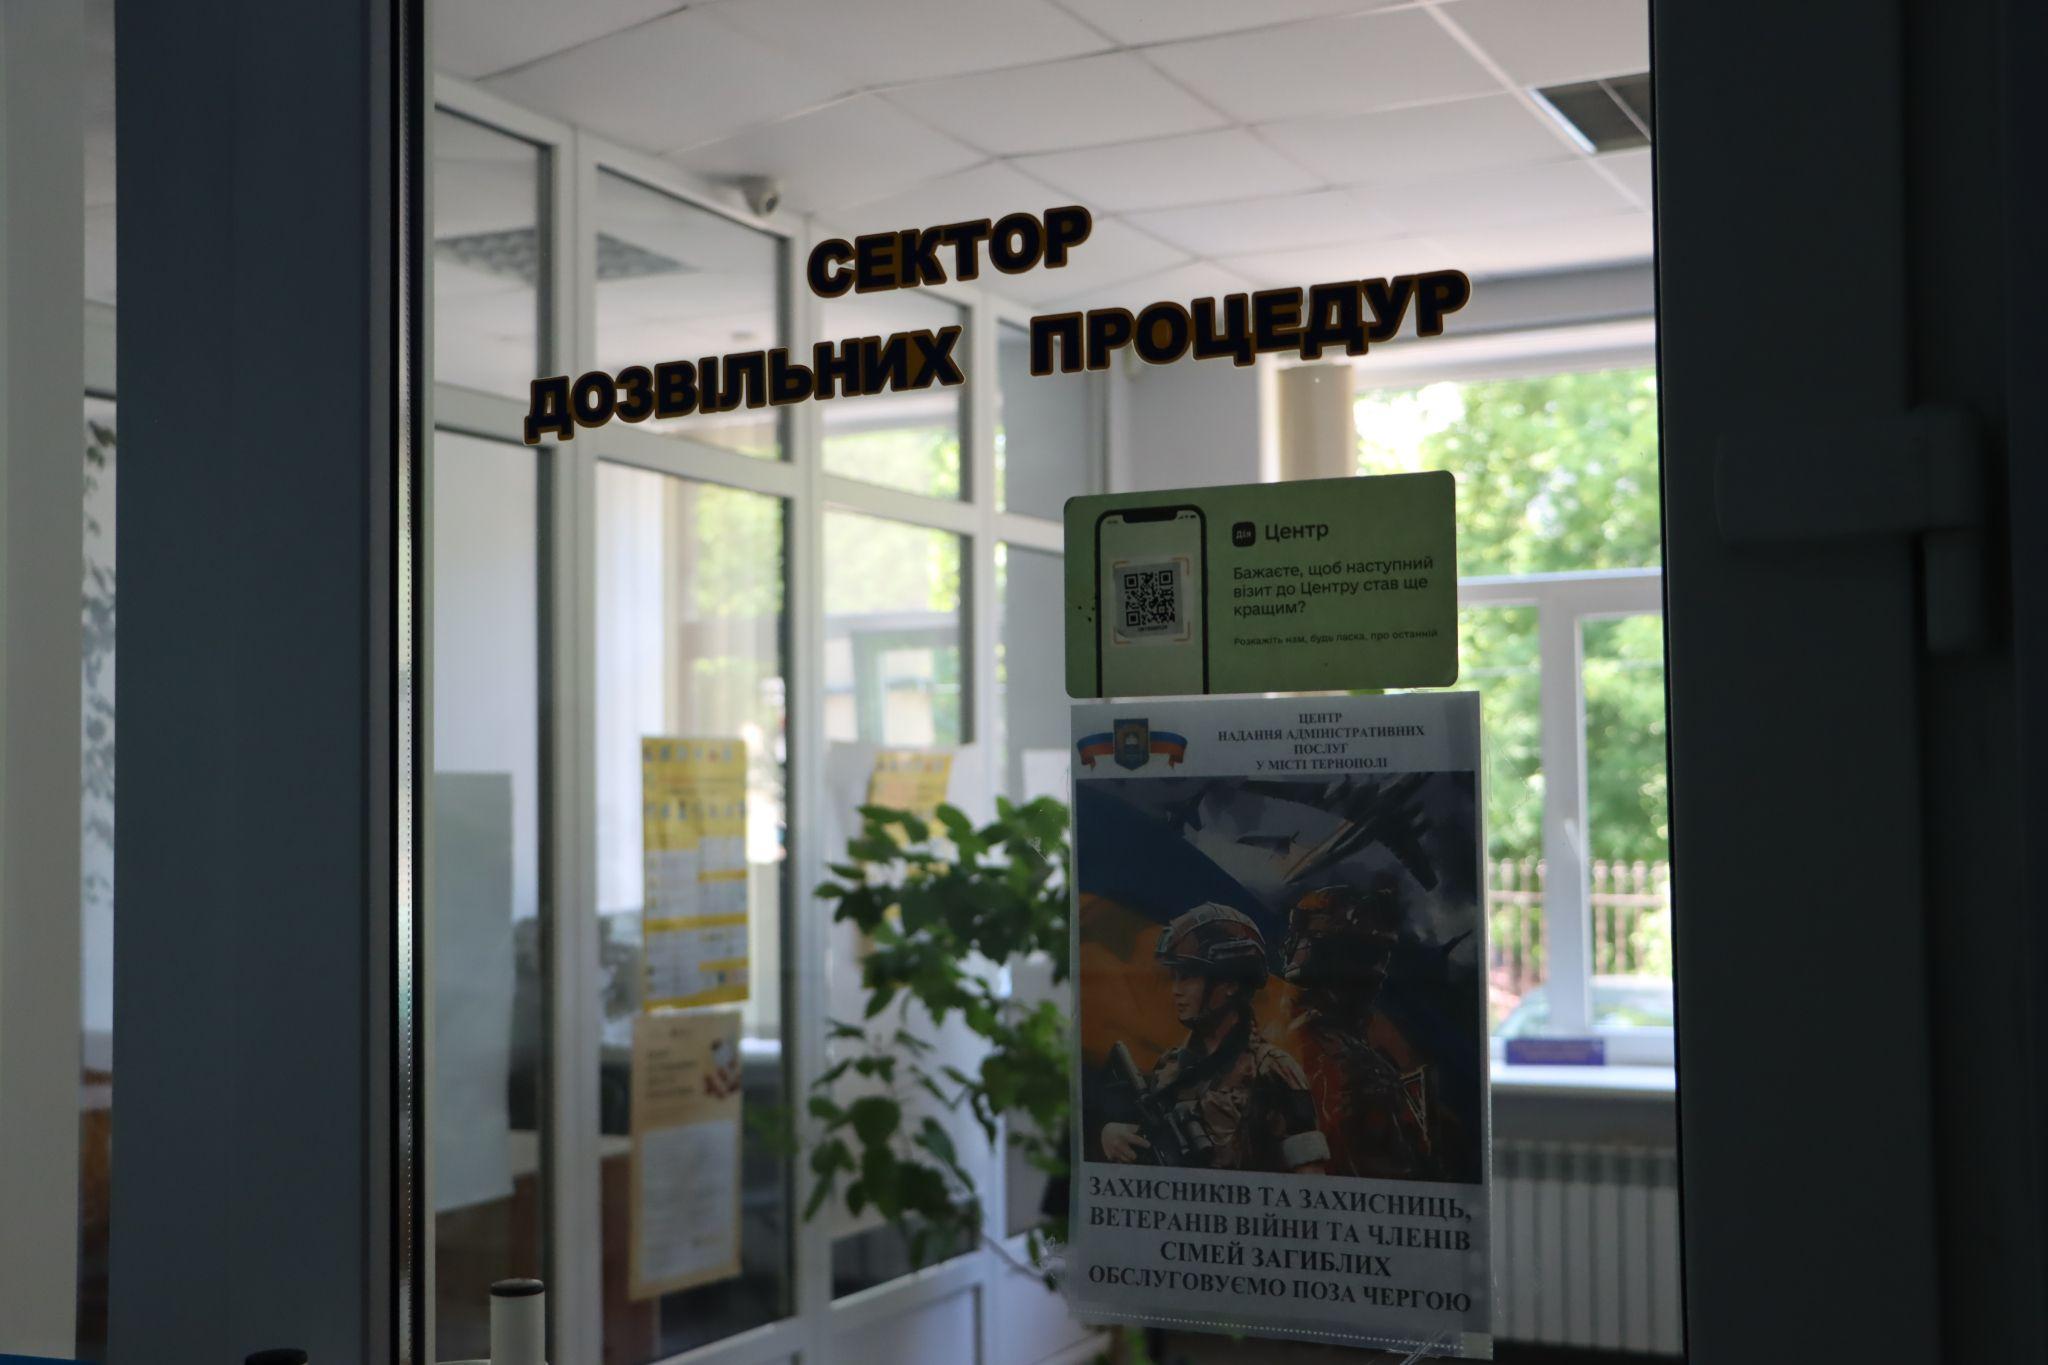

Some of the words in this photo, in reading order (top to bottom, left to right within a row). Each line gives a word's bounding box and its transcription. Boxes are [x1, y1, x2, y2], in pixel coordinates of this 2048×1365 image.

[806, 205, 1092, 299] СЕКТОР
[524, 325, 965, 444] ДОЗВІЛЬНИХ
[1030, 269, 1471, 376] ПРОЦЕДУР
[1265, 524, 1328, 542] Центр
[1233, 564, 1303, 580] Бажаєте,
[1309, 561, 1342, 577] щоб
[1346, 556, 1434, 576] наступний
[1233, 583, 1271, 598] візит
[1276, 584, 1296, 598] до
[1300, 580, 1358, 597] Центру
[1363, 578, 1399, 591] став
[1404, 576, 1428, 591] ще
[1233, 600, 1307, 618] кращим?
[1233, 636, 1283, 646] Розкажіть
[1310, 632, 1334, 645] будь
[1371, 632, 1389, 643] про
[1392, 628, 1439, 640] останній
[1298, 712, 1343, 725] ЦЕНТР
[1217, 728, 1283, 742] НАДАННЯ
[1285, 725, 1426, 741] АДМІНІСТРАТИВНИХ
[1293, 742, 1349, 755] ПОСЛУГ
[1255, 759, 1266, 771] У
[1268, 758, 1309, 771] МІСТІ
[1311, 756, 1388, 770] ТЕРНОПОЛІ
[1088, 1176, 1251, 1206] ЗАХИСНИКІВ
[1258, 1186, 1292, 1208] ТА
[1299, 1188, 1472, 1224] ЗАХИСНИЦЬ,
[1089, 1206, 1228, 1236] ВЕТЕРАНІВ
[1235, 1213, 1319, 1240] ВІЙНИ
[1326, 1221, 1360, 1243] ТА
[1368, 1225, 1471, 1251] ЧЛЕНІВ
[1160, 1240, 1244, 1266] СІМЕЙ
[1251, 1247, 1392, 1278] ЗАГИБЛИХ
[1088, 1265, 1286, 1299] ОБСЛУГОВУЄМО
[1293, 1279, 1355, 1304] ПОЗА
[1362, 1286, 1472, 1313] ЧЕРГОЮ
